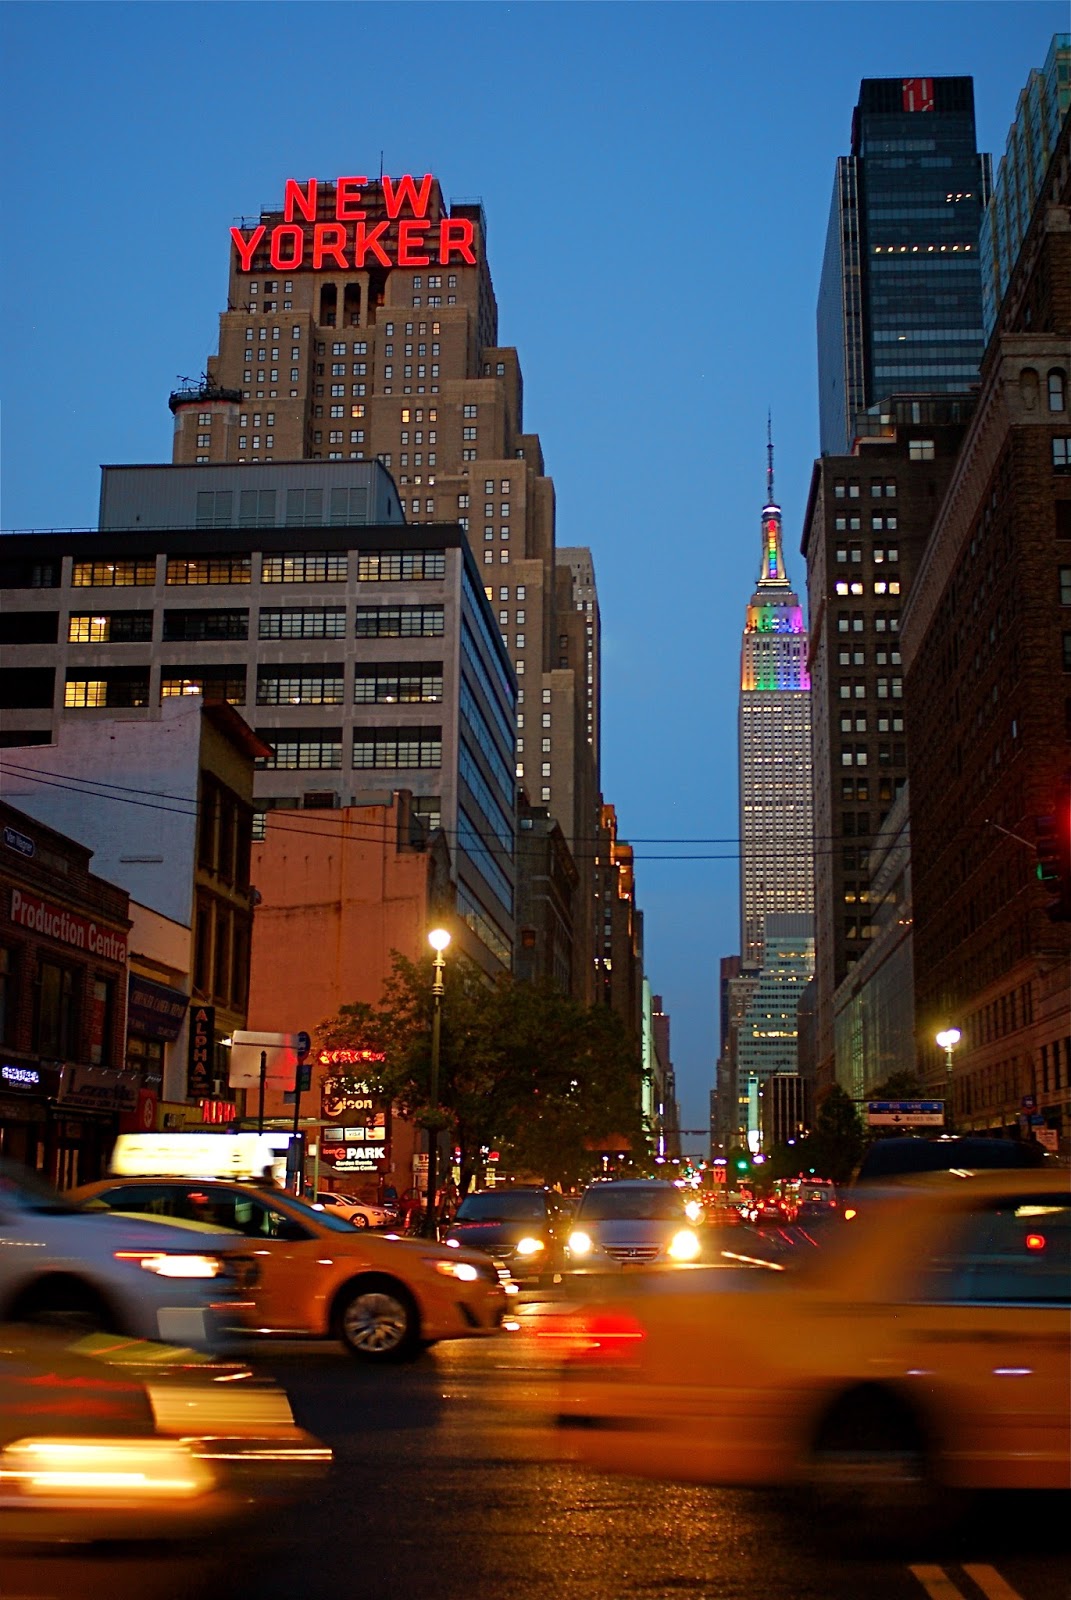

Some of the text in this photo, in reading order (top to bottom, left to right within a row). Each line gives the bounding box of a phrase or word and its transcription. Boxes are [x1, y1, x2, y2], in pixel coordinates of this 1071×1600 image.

[284, 173, 433, 222] NEW
[229, 218, 477, 271] YORKER
[10, 889, 85, 948] Production
[193, 1008, 208, 1075] ALPHA
[342, 1098, 372, 1109] icon
[346, 1147, 385, 1159] PARK
